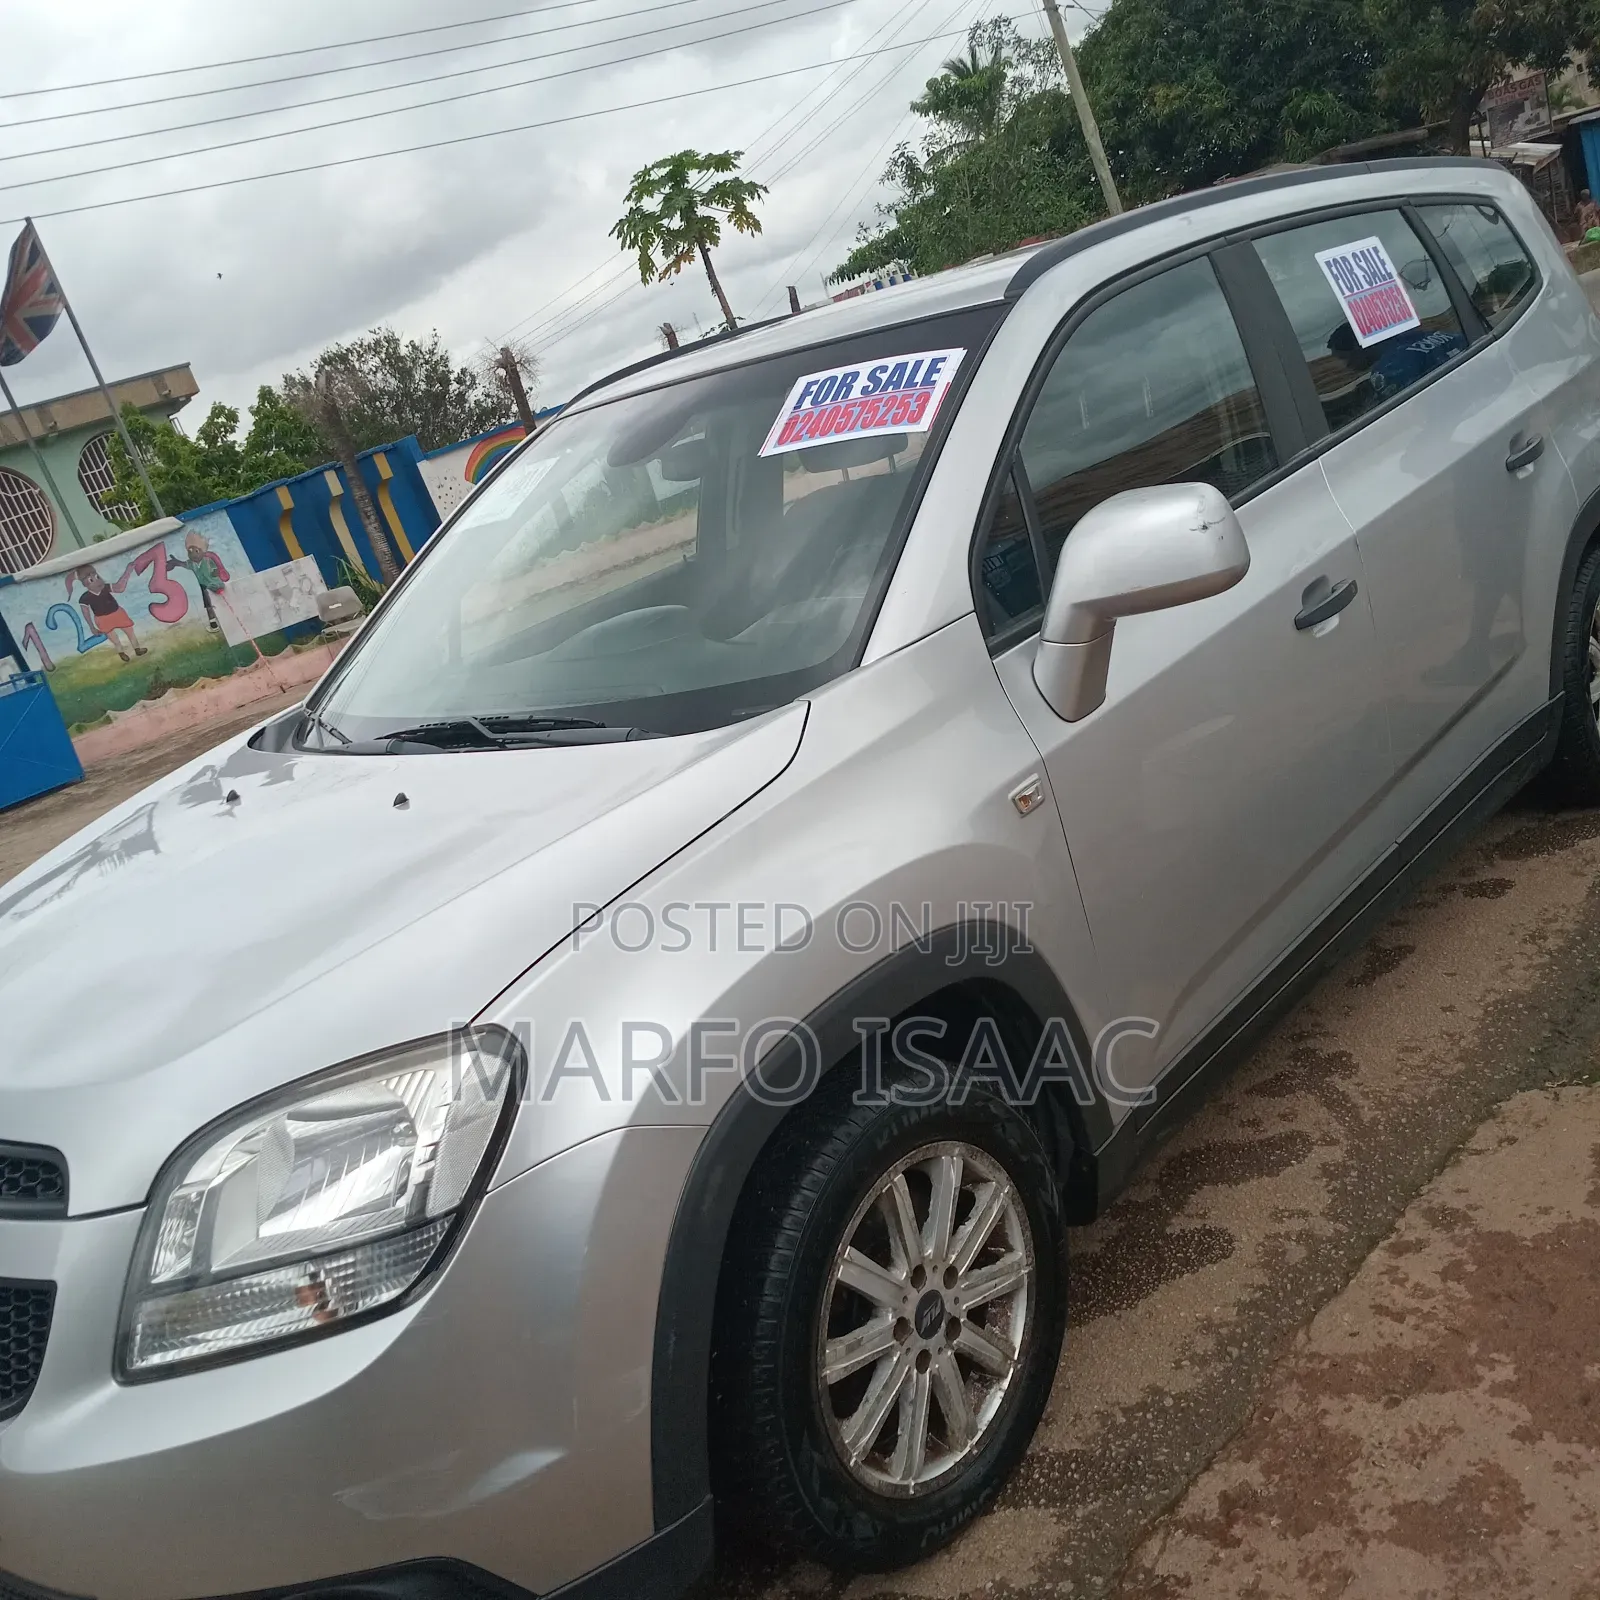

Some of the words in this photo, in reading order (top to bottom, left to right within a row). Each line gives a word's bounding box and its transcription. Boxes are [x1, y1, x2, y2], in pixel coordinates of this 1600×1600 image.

[1324, 255, 1364, 296] FOR
[1351, 246, 1394, 287] SALE
[793, 370, 861, 411] FOR
[860, 356, 948, 396] SALE
[777, 391, 932, 446] 0240575253
[22, 621, 57, 672] 1
[45, 603, 107, 654] 2
[134, 541, 189, 623] 3
